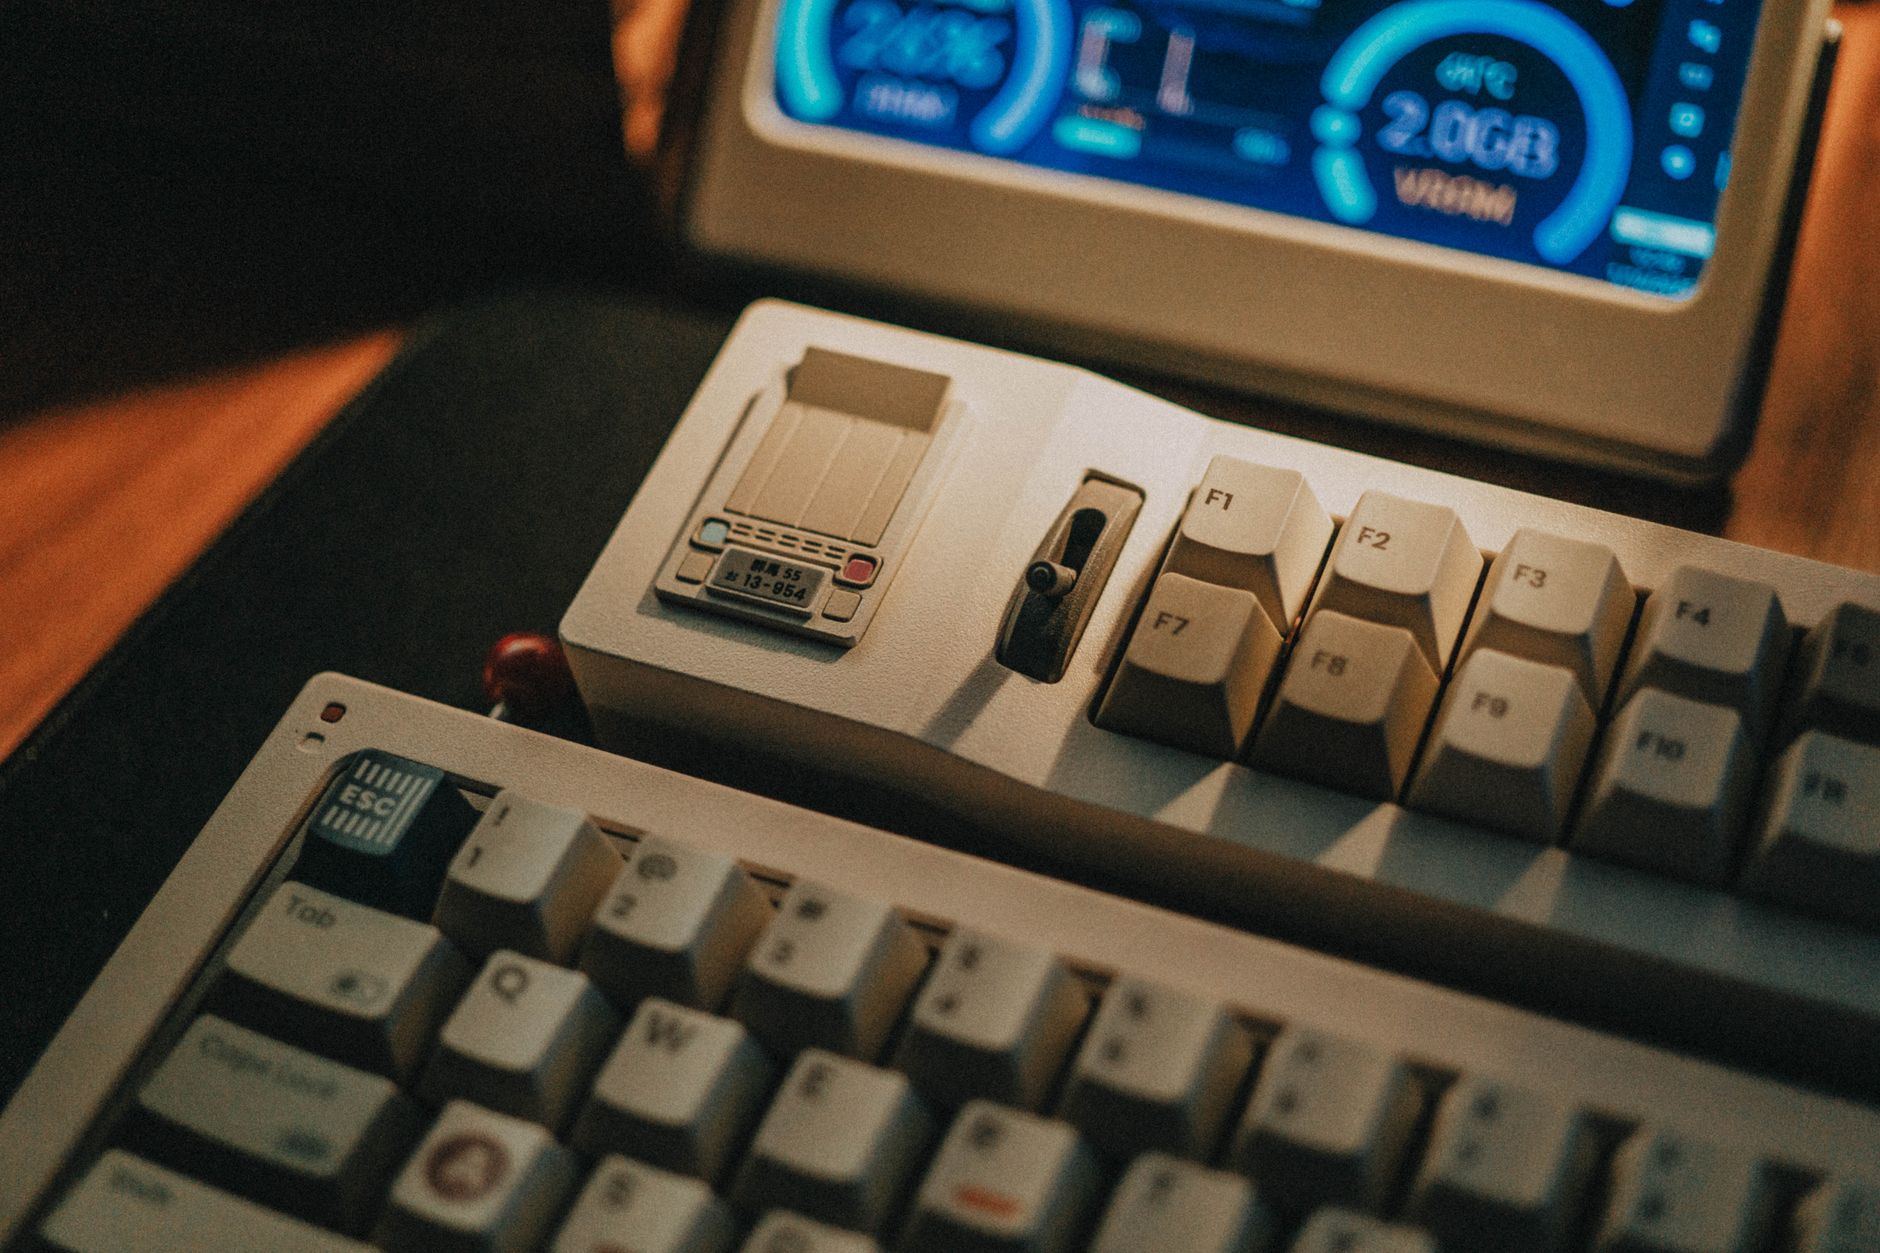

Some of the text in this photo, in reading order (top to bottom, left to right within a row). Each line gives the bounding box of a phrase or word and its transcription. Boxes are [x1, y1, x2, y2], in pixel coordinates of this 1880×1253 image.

[1376, 90, 1560, 180] 2.0GB
[1204, 487, 1234, 510] F1
[1357, 525, 1391, 551] F2
[743, 573, 807, 601] 13-954
[1513, 562, 1548, 589] F3
[1152, 611, 1190, 636] F7
[1673, 601, 1711, 627] F4
[1311, 649, 1350, 676] F8
[1470, 691, 1509, 719] F9
[339, 783, 398, 817] ESC
[284, 893, 337, 929] Tab
[612, 893, 638, 919] 2
[490, 962, 529, 1006] Q
